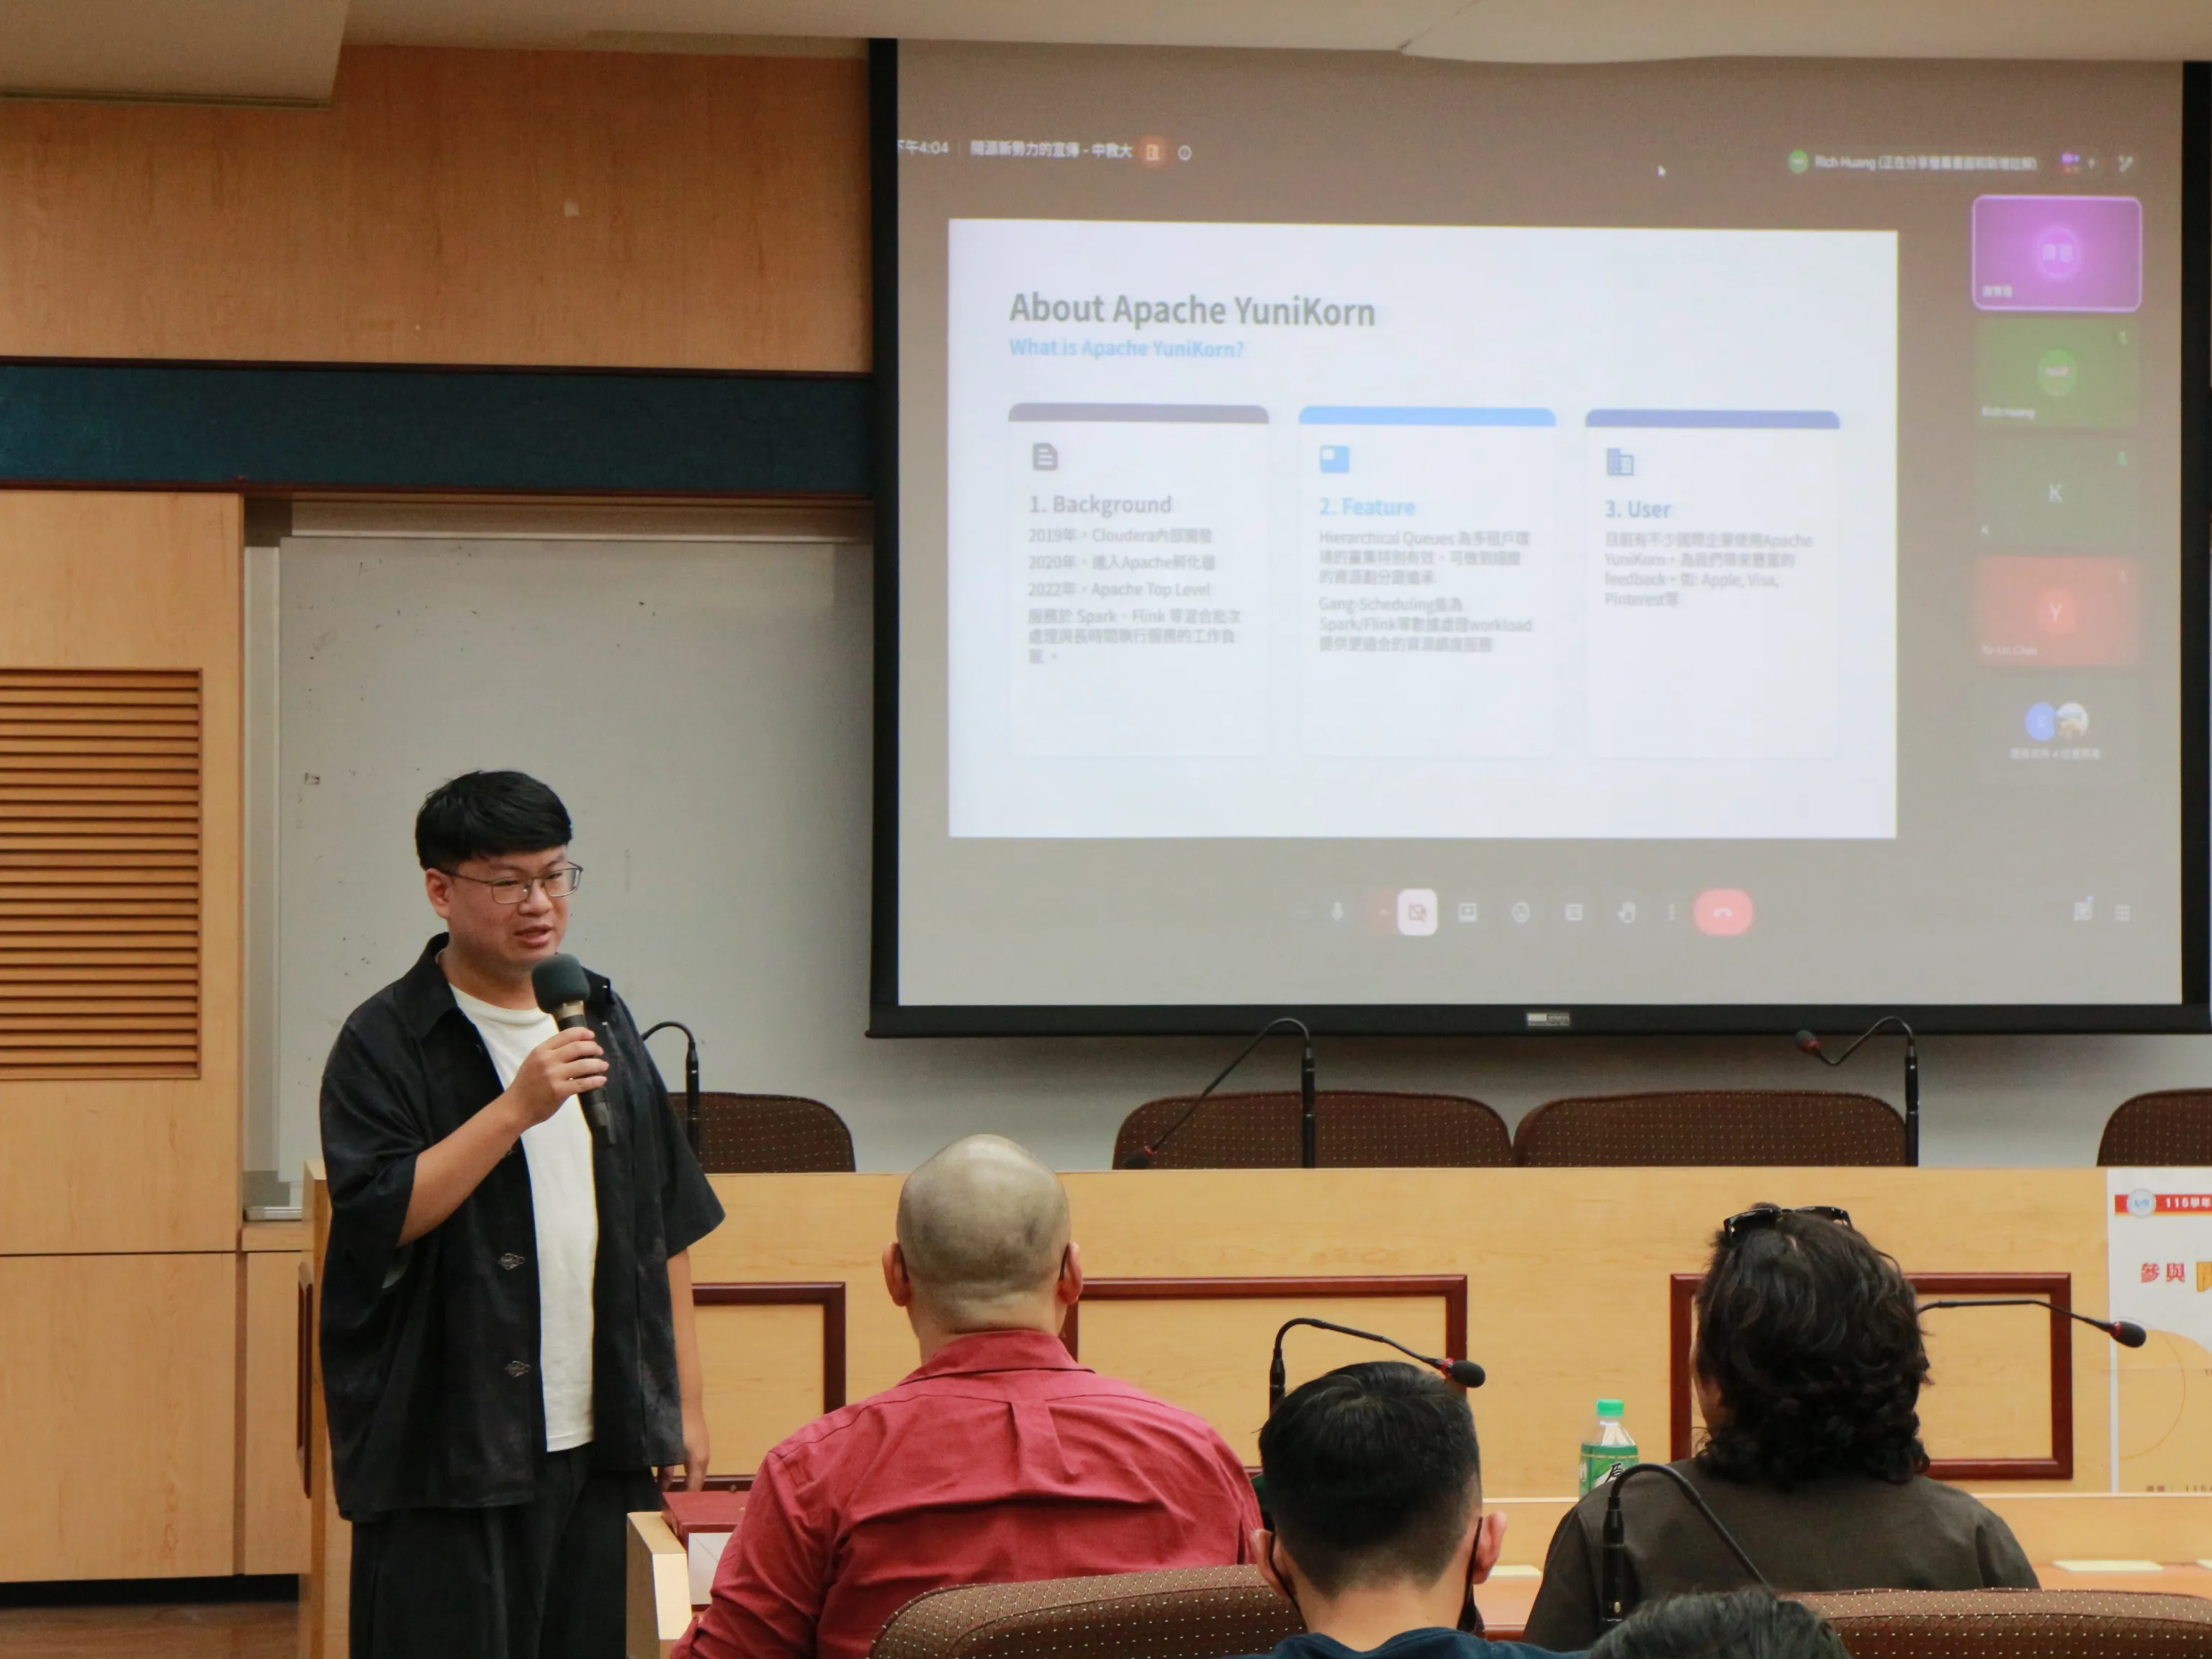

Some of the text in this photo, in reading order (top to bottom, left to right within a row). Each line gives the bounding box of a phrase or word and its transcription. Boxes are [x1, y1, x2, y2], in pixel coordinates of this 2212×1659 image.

[1009, 291, 1375, 331] About Apache YuniKorn
[1009, 338, 1245, 359] What is Apache YuniKorn?
[2049, 482, 2062, 503] K
[1030, 494, 1172, 518] 1. Background
[1318, 496, 1417, 517] 2. Feature
[1605, 499, 1673, 519] 3. User
[1318, 530, 1401, 545] Hierarchical
[1402, 530, 1456, 549] Queues
[1146, 582, 1173, 599] Top
[1174, 582, 1211, 597] Level
[2049, 603, 2062, 623] Y
